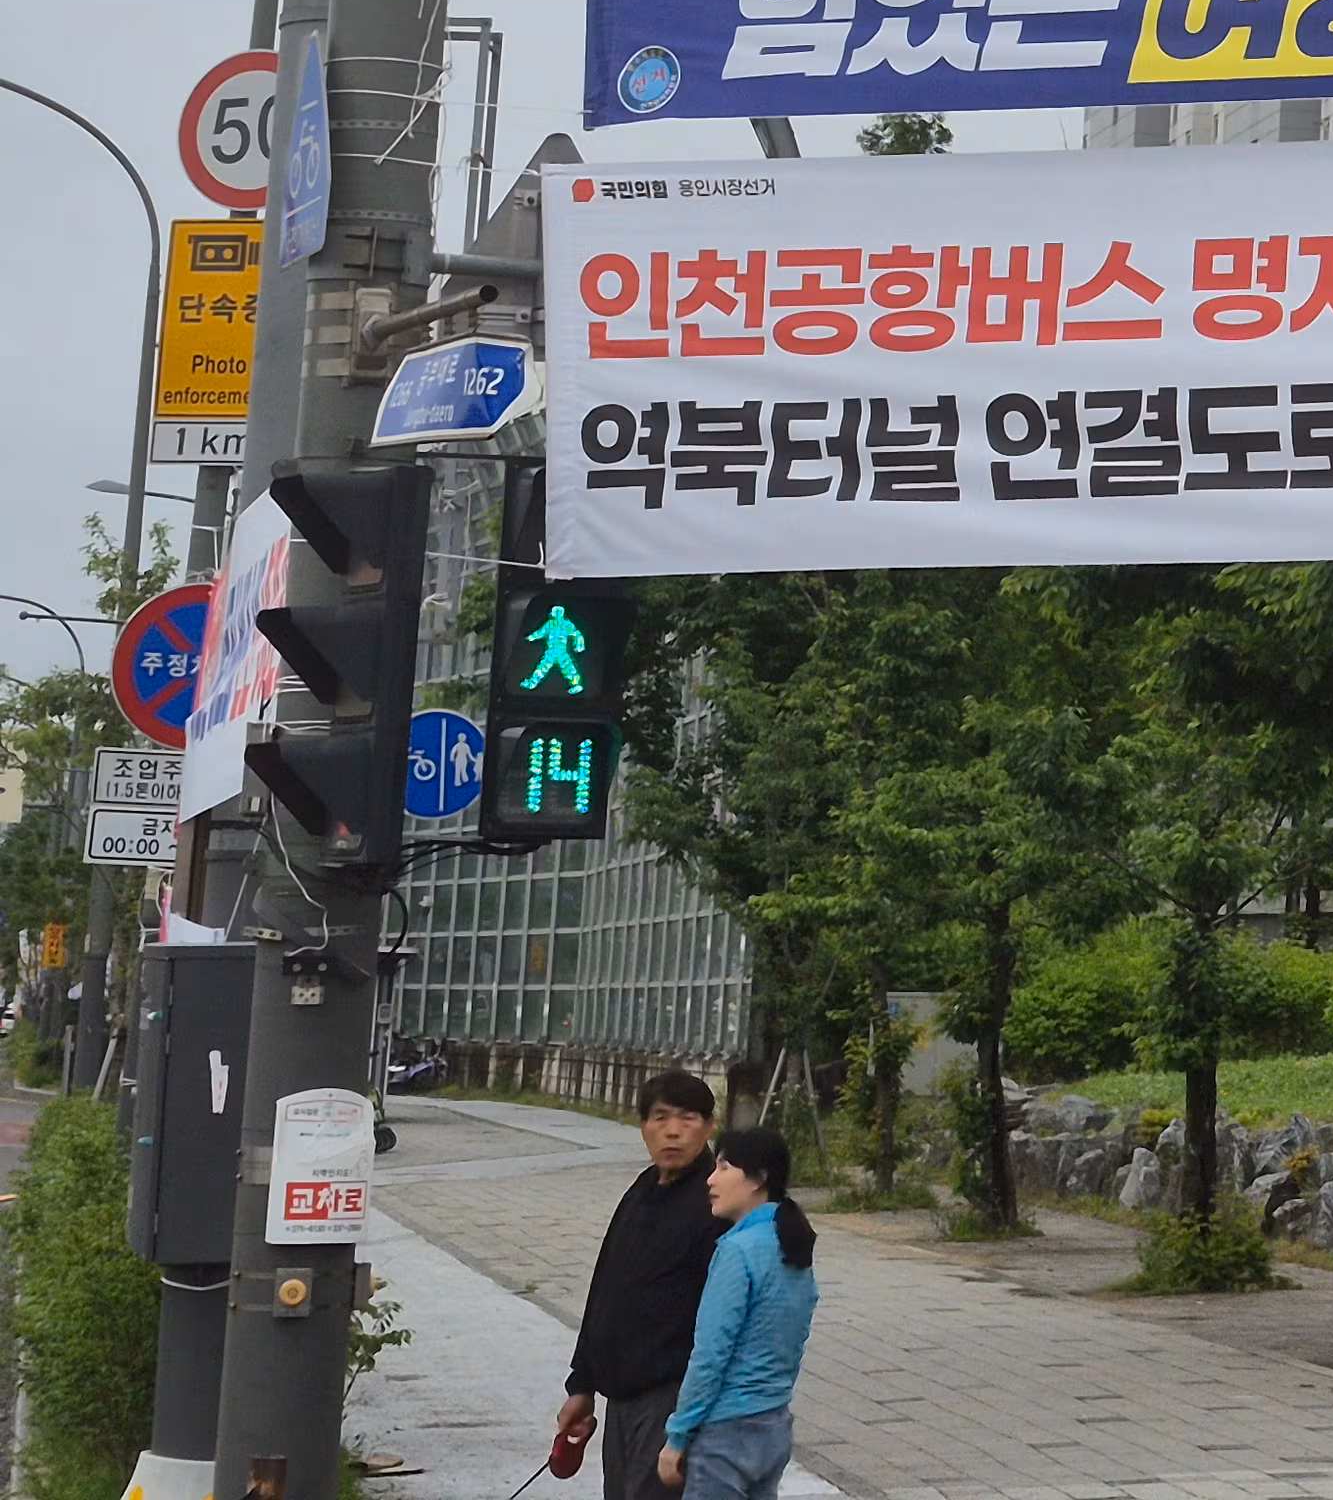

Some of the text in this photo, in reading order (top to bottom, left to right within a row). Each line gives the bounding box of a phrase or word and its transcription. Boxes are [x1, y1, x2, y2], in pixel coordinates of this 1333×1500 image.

[601, 178, 775, 199] 국민의힘 용인시장선거
[579, 241, 1165, 359] 인천공항버스
[192, 355, 247, 374] Photo
[463, 368, 504, 395] 1262
[176, 427, 246, 456] 1 km
[581, 395, 961, 510] 역북터널
[526, 738, 592, 813] 14
[103, 837, 159, 855] 00:00
